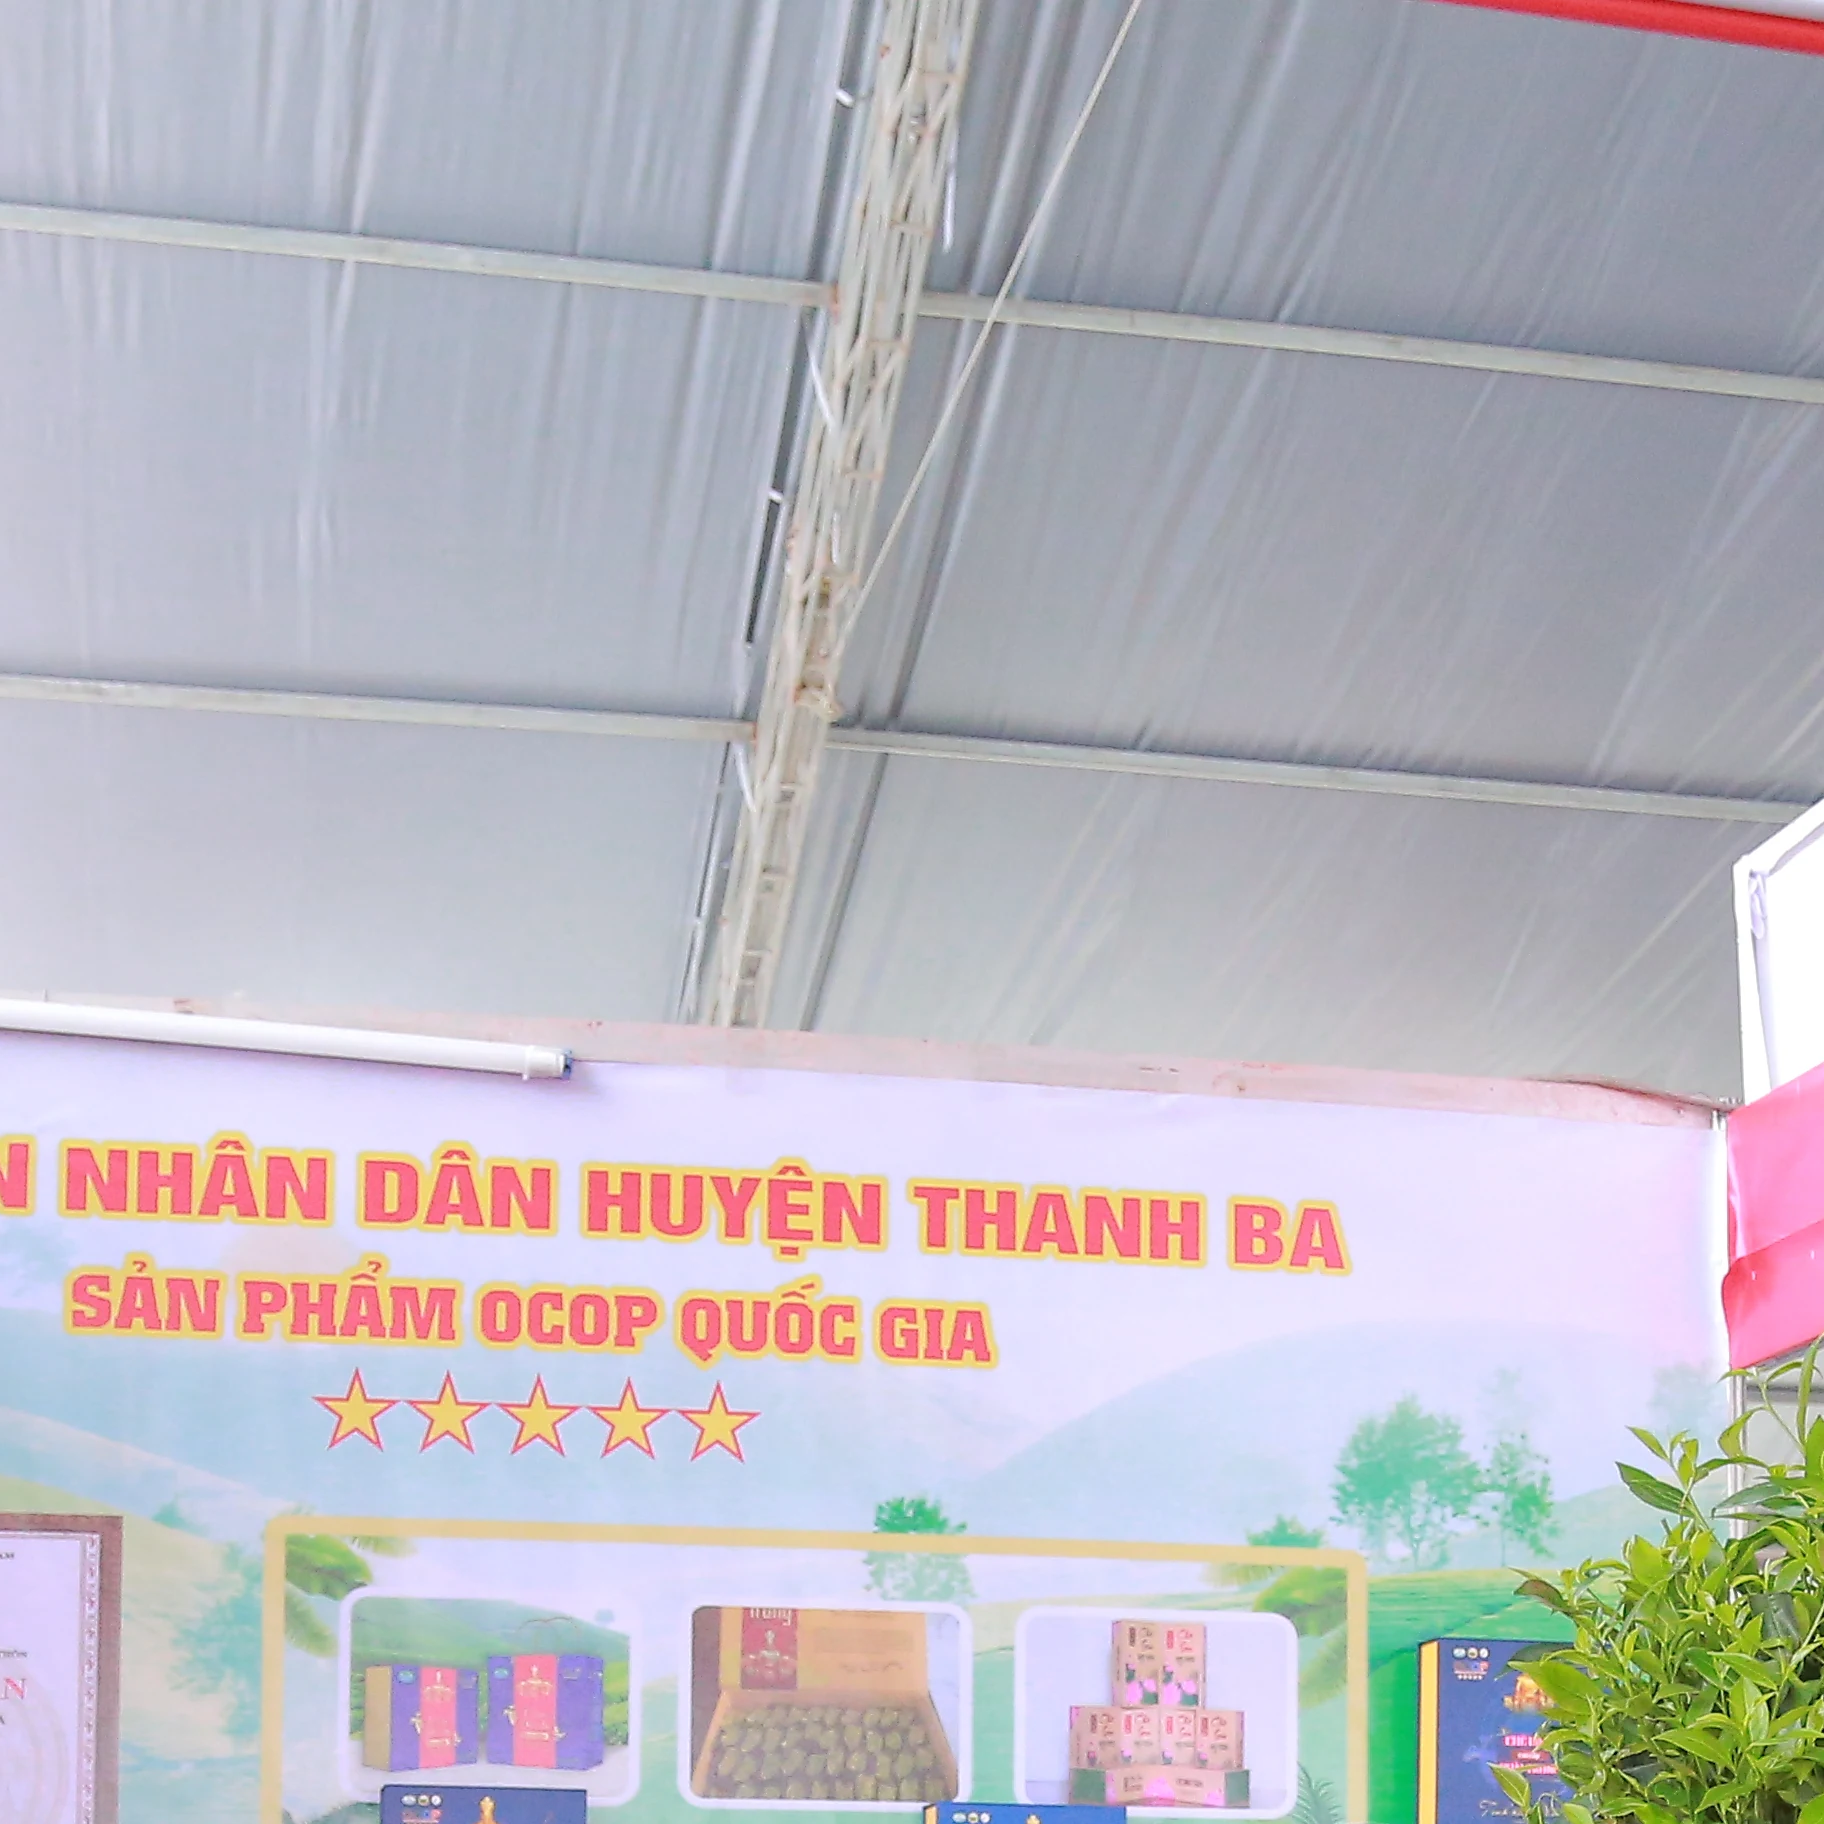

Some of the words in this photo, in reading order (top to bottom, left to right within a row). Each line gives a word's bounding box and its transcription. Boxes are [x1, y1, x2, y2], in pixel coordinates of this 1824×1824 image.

[65, 1138, 331, 1223] NHÂN
[362, 1150, 552, 1230] DÂN
[587, 1166, 882, 1255] HUYỆN
[914, 1185, 1202, 1262] THANH
[1231, 1202, 1346, 1270] BA
[71, 1260, 220, 1334] SẢN
[241, 1261, 457, 1340] PHẨM
[479, 1289, 658, 1348] OCOP
[680, 1282, 857, 1362] QUỐC
[879, 1308, 992, 1362] GIA
